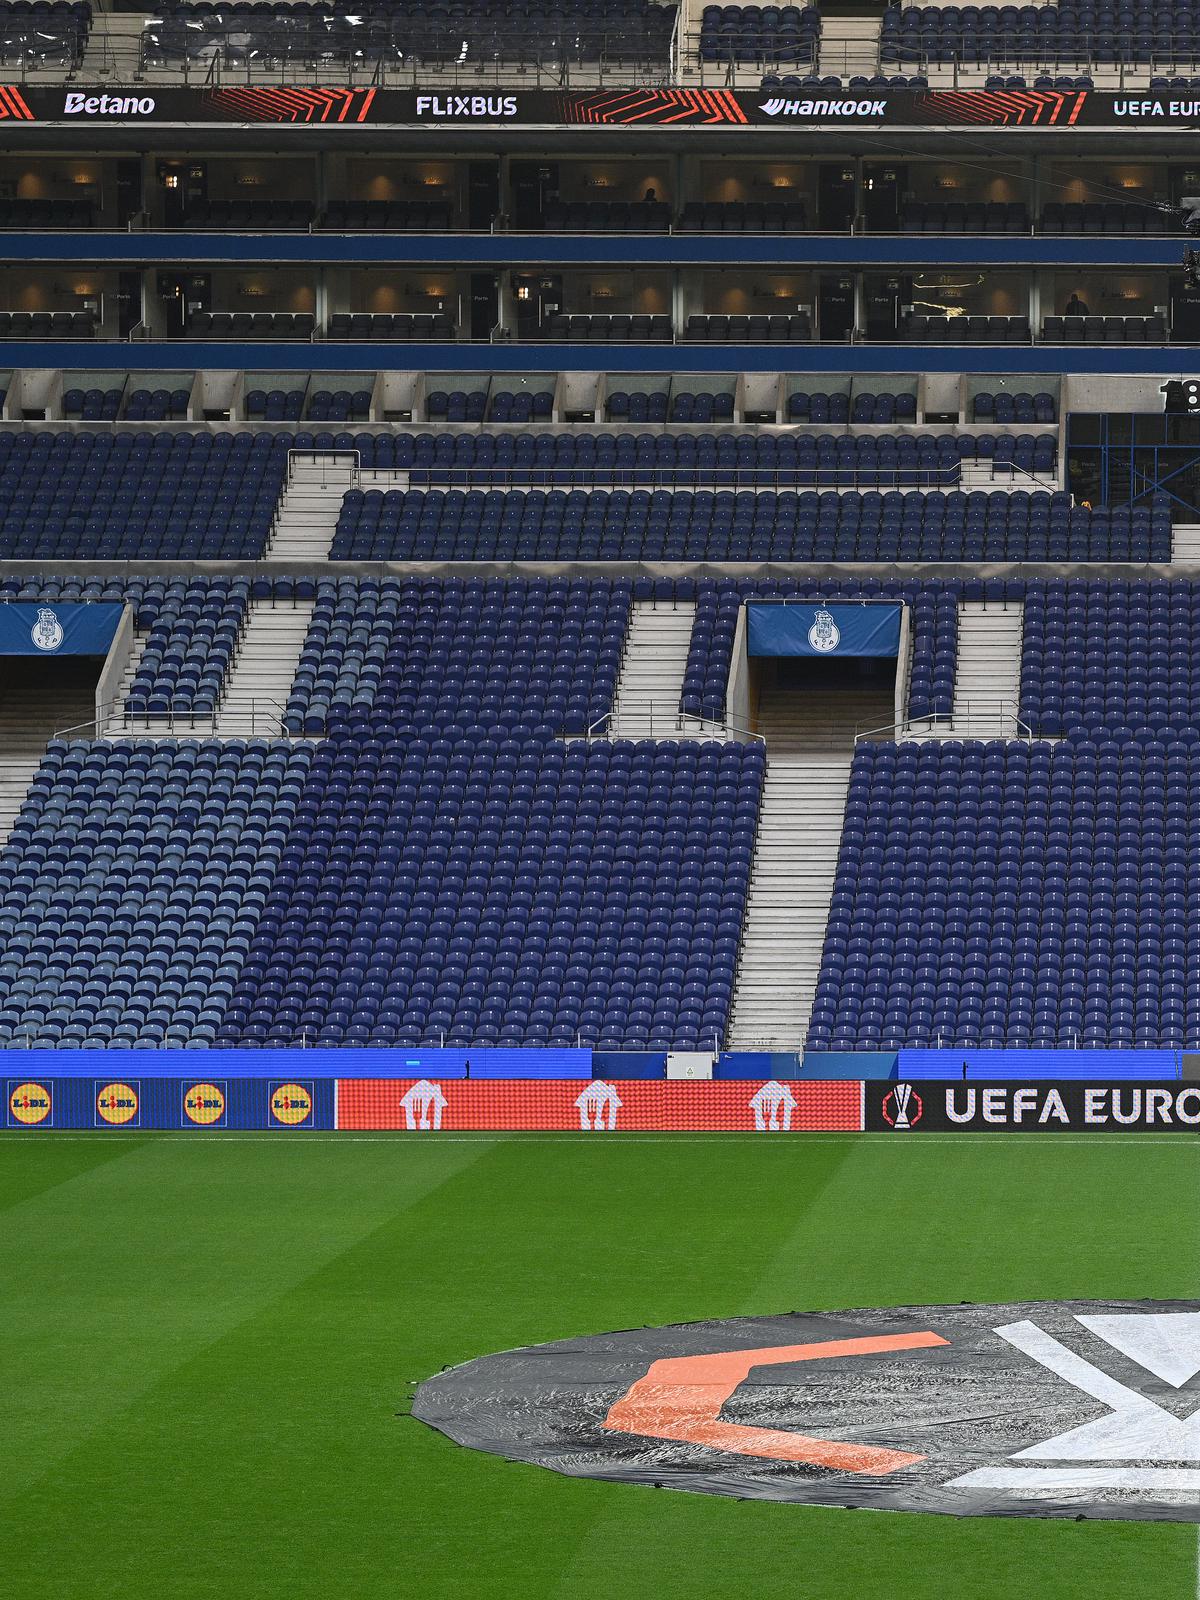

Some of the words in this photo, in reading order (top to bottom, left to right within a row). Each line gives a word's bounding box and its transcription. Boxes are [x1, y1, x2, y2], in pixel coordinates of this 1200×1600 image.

[63, 92, 156, 115] Betano
[1113, 100, 1165, 116] UEFA
[945, 1088, 1070, 1124] UEFA
